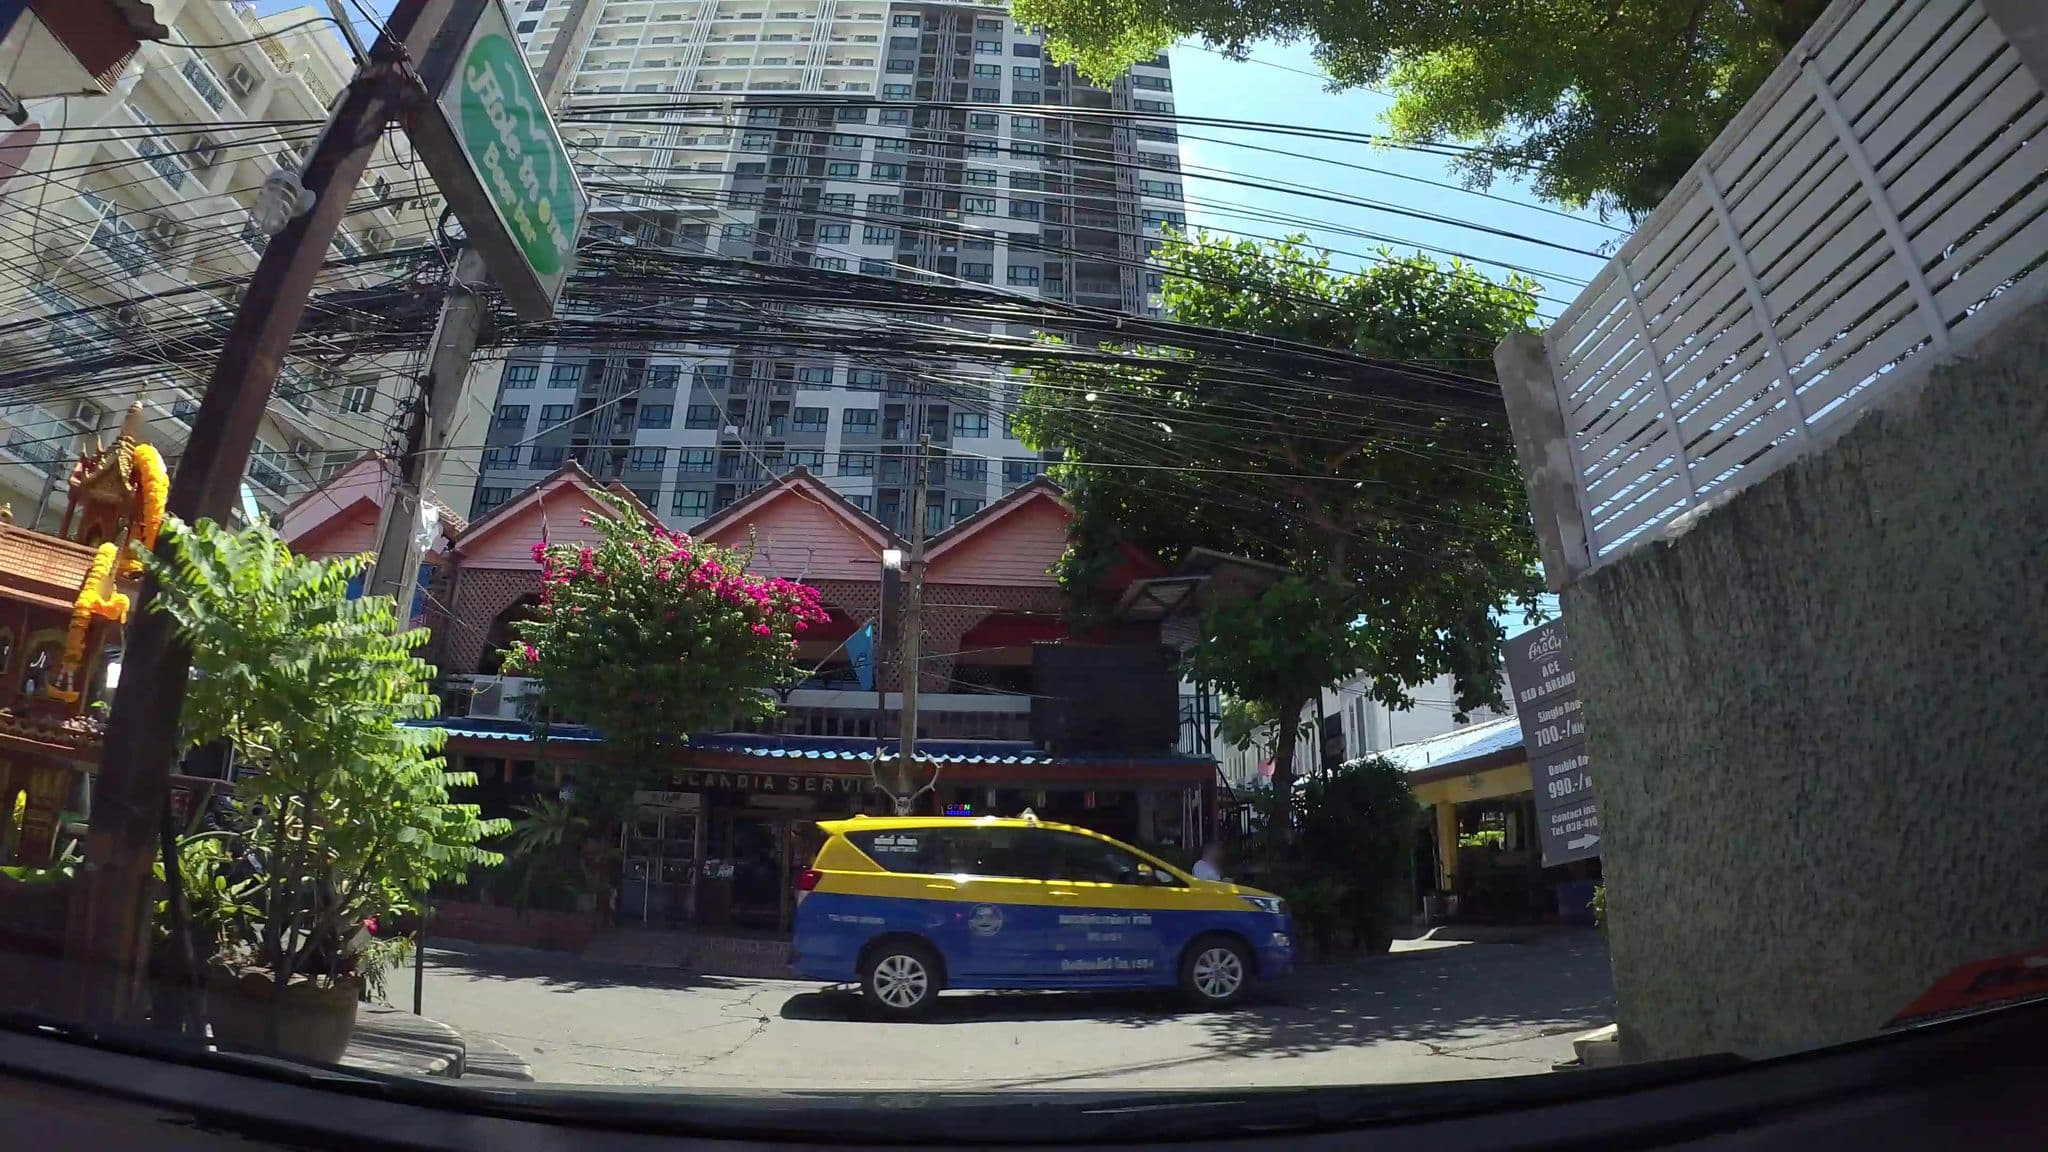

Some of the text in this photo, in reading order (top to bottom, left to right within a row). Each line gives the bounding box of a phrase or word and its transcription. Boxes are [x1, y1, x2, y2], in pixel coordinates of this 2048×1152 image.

[1542, 660, 1561, 678] ACE
[1520, 687, 1538, 703] BED
[1537, 686, 1546, 697] &
[1537, 699, 1583, 724] Single Roo
[1548, 758, 1578, 777] Double
[671, 772, 863, 793] SCANDIA SERVI
[1551, 807, 1582, 824] Contact
